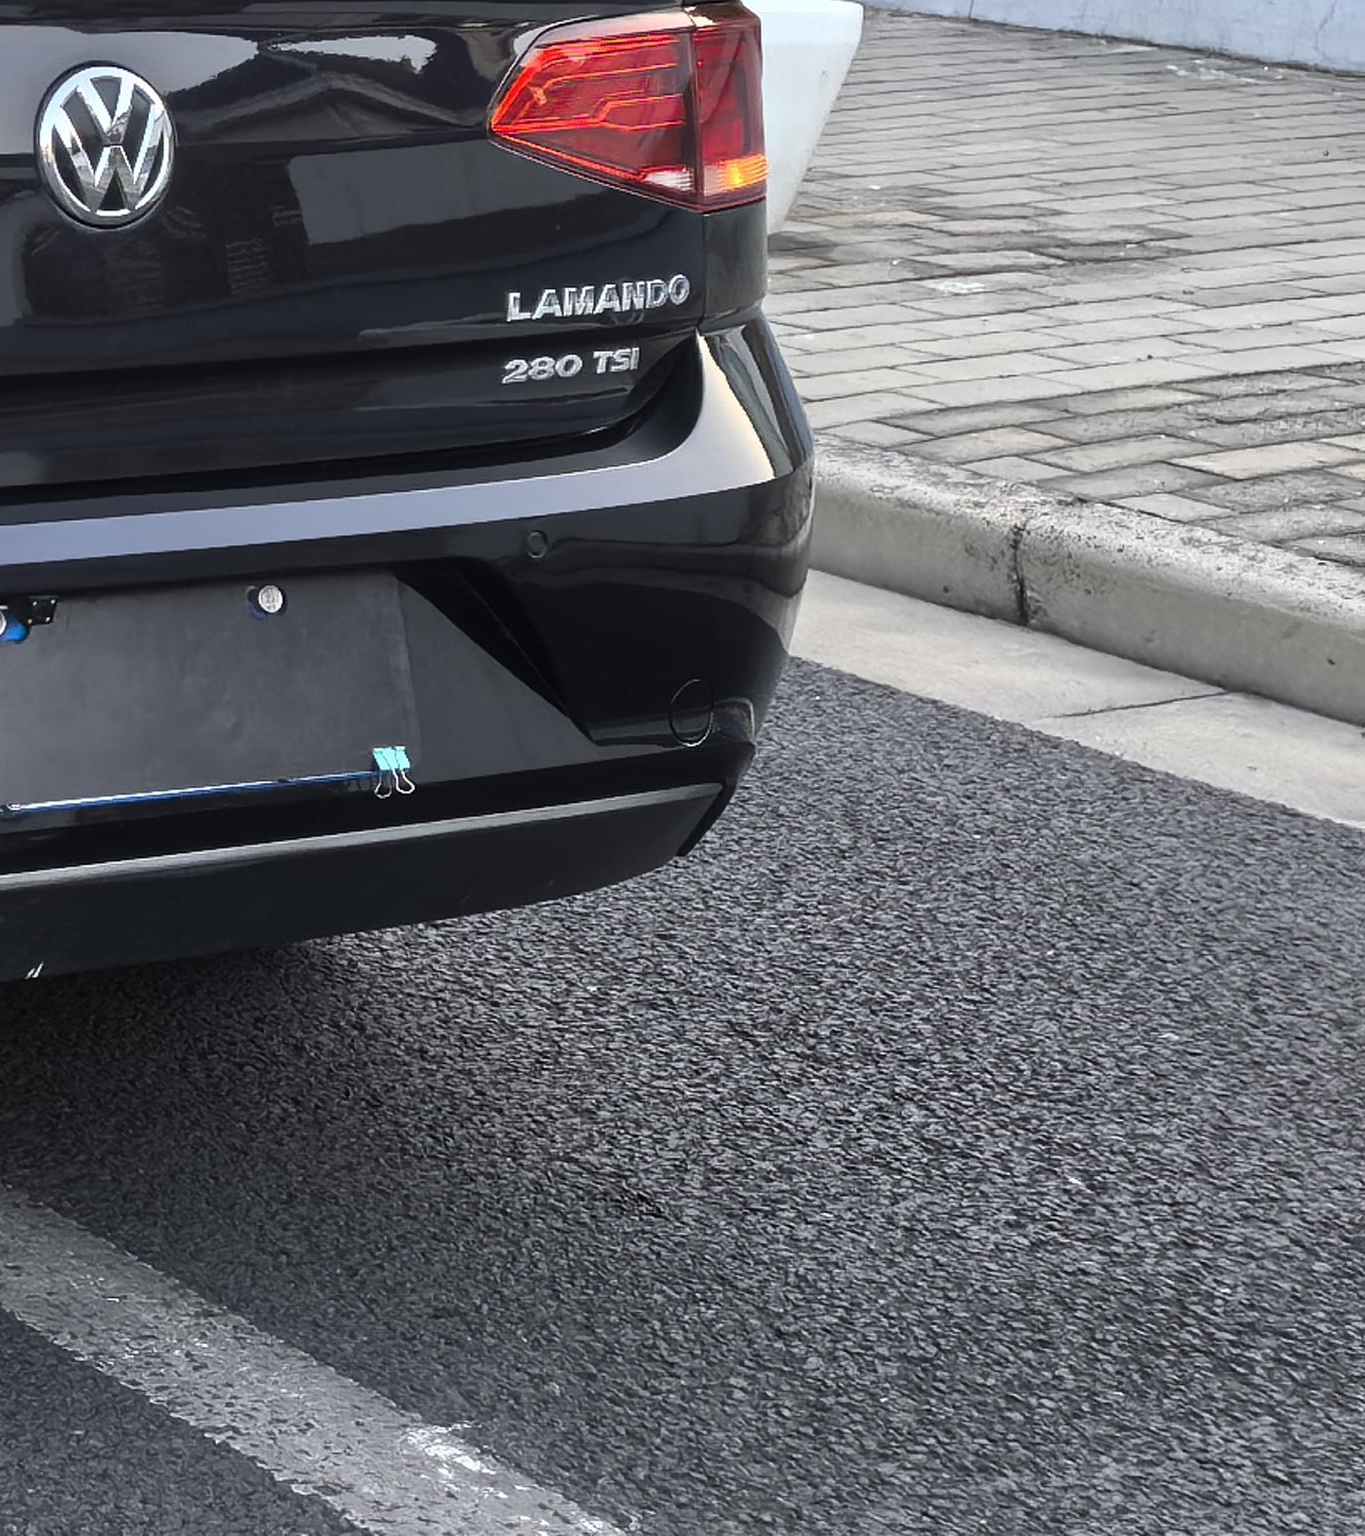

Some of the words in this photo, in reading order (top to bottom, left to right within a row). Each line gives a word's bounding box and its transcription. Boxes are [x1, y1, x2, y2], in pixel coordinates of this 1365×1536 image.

[39, 66, 173, 220] VW
[506, 274, 690, 322] LAMANDO
[501, 354, 583, 384] 280
[593, 347, 640, 374] TSI
